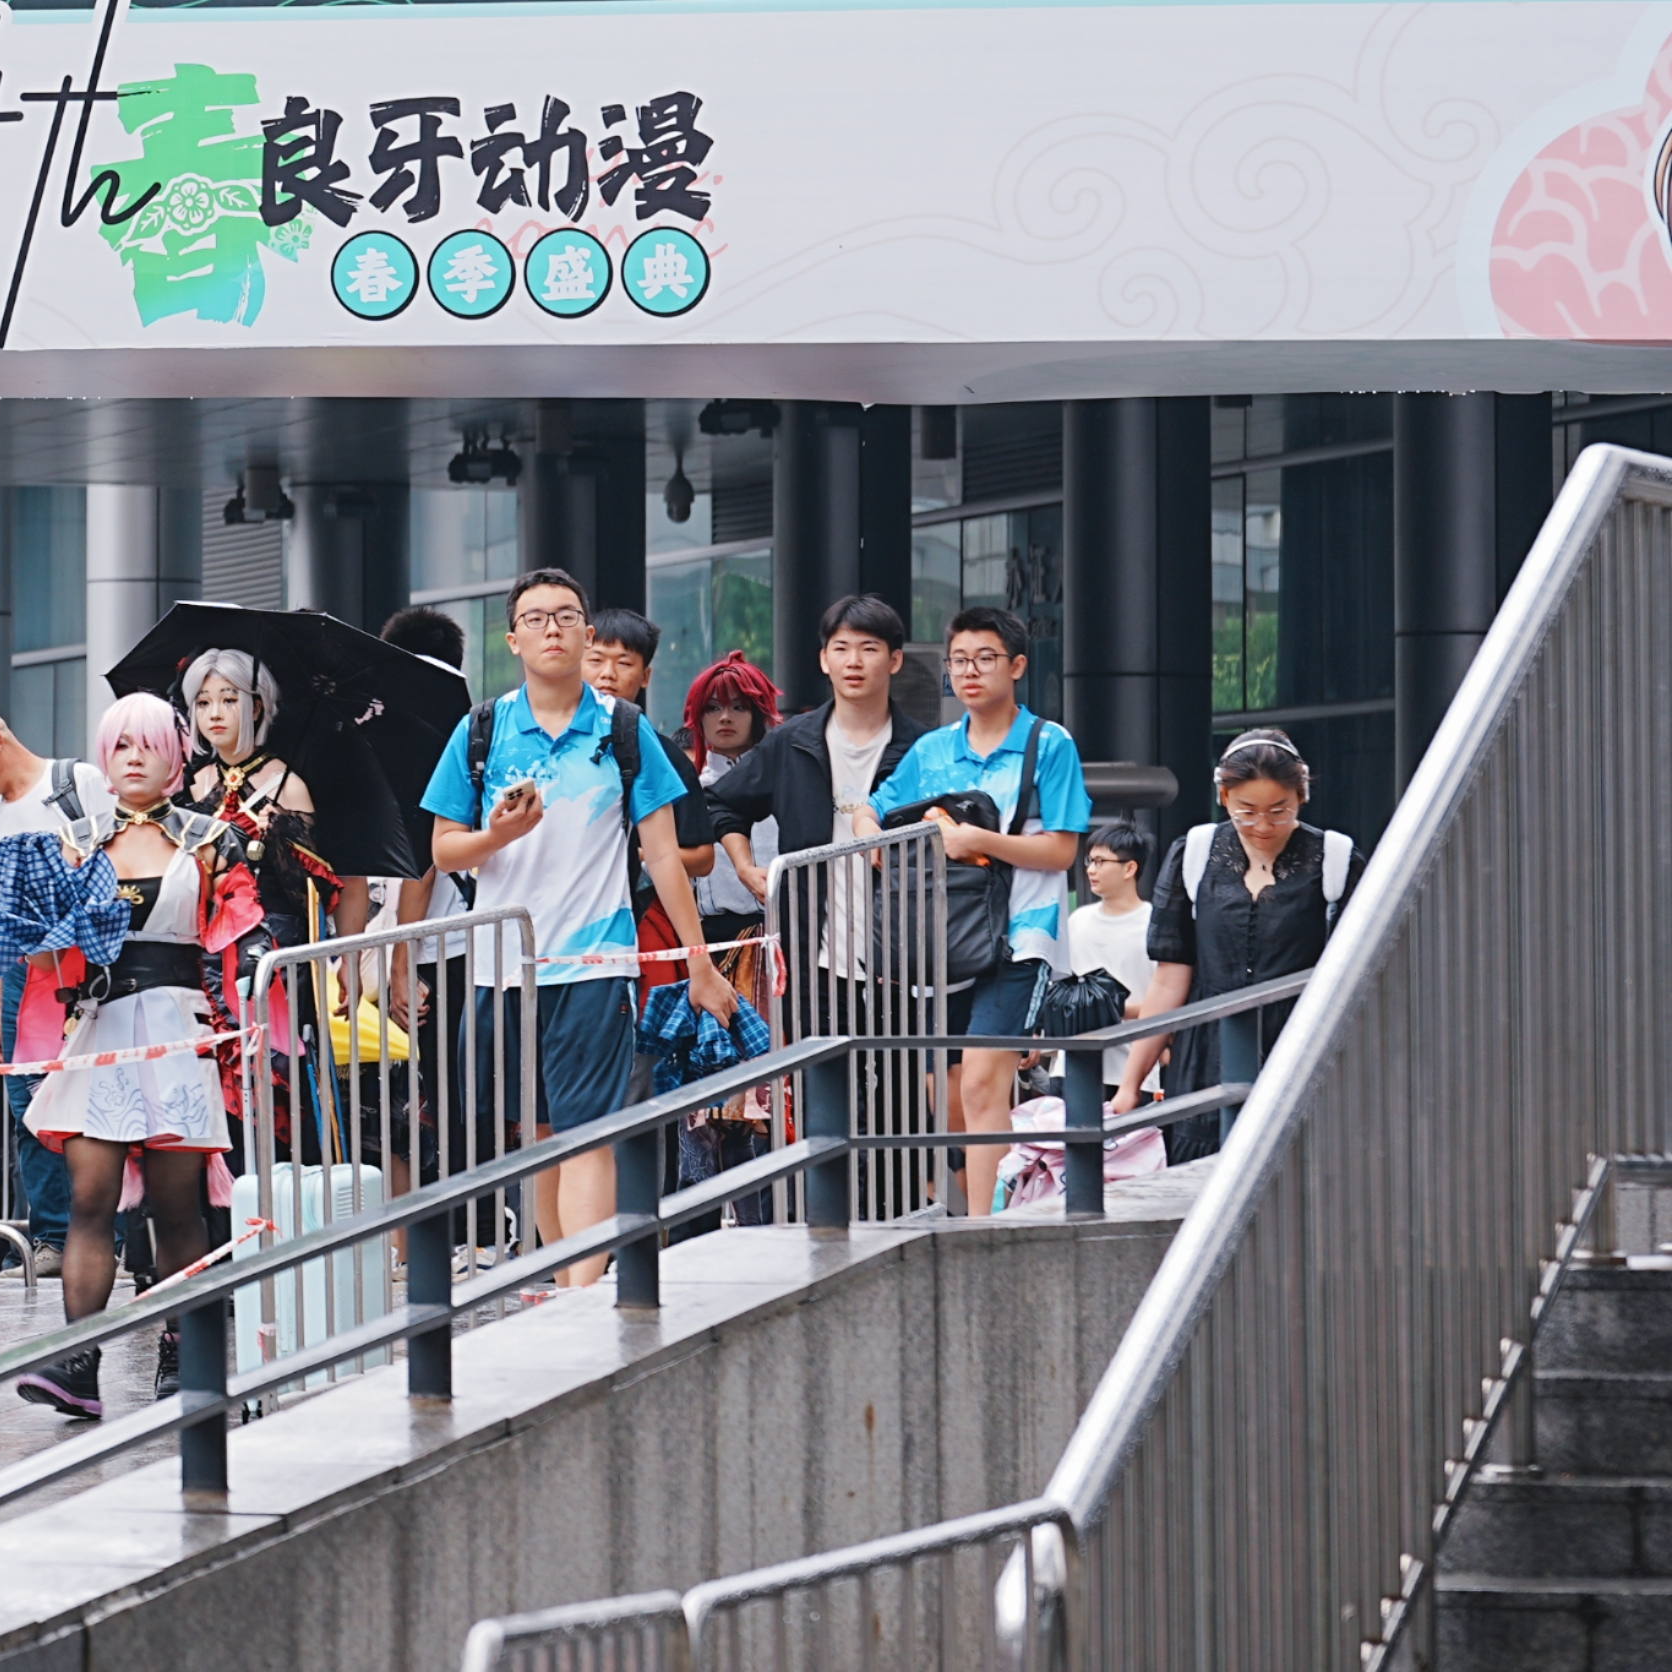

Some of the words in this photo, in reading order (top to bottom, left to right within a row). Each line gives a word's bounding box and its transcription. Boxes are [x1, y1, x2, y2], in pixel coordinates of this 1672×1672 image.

[258, 91, 715, 229] 良牙动漫
[344, 241, 697, 305] 春季盛典
